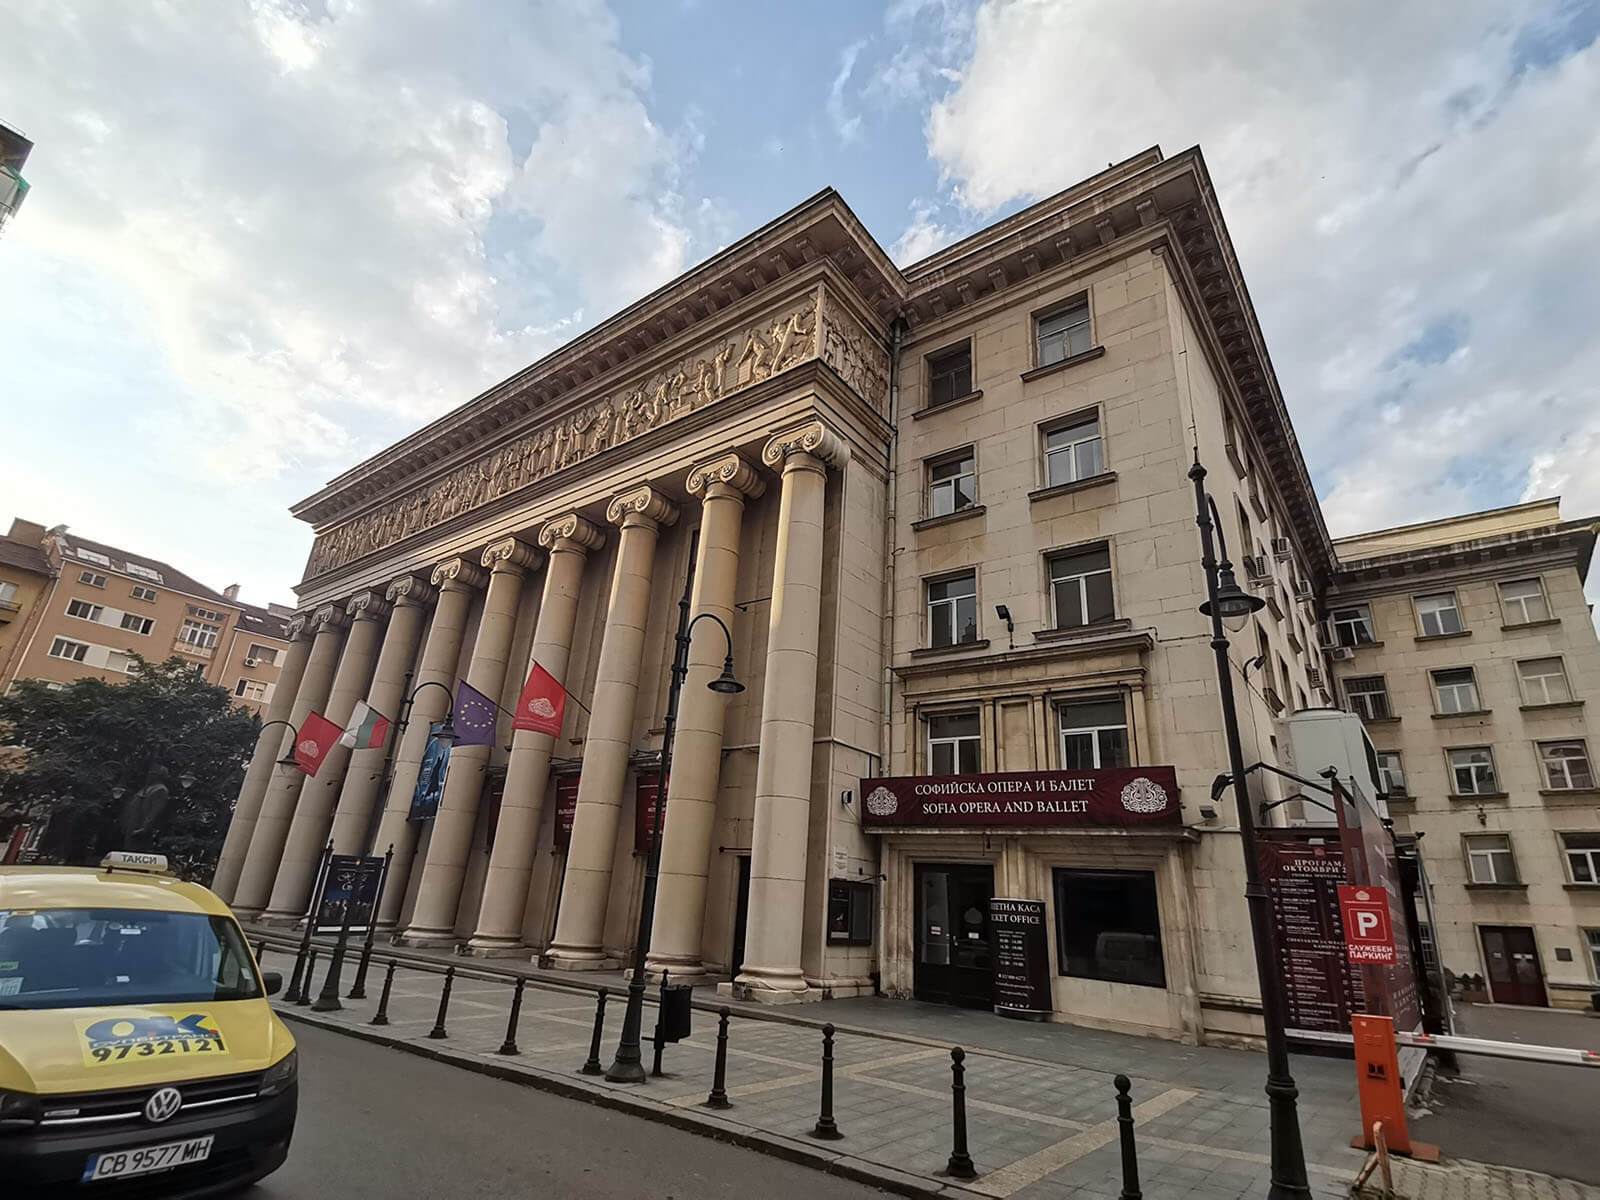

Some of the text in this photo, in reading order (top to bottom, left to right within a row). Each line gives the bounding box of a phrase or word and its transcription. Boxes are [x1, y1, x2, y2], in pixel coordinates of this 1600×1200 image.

[915, 778, 1095, 796] СОФИЙСКА ОПЕРА И БАЛЕТ
[922, 800, 1088, 815] SOFIA OPERA AND BALLET
[121, 854, 157, 865] ТАКСИ
[1294, 859, 1346, 867] ПРОГРАМ
[1282, 865, 1339, 873] ОКТОМВРИ
[1010, 914, 1041, 925] OFFICE
[1356, 911, 1378, 937] P
[1348, 944, 1393, 953] СЛУЖЕБЕН
[1349, 951, 1393, 961] ПАРКИНГ
[92, 1038, 226, 1062] 9732121
[98, 1154, 128, 1176] CB
[131, 1144, 182, 1170] 9577
[181, 1139, 210, 1161] MH
